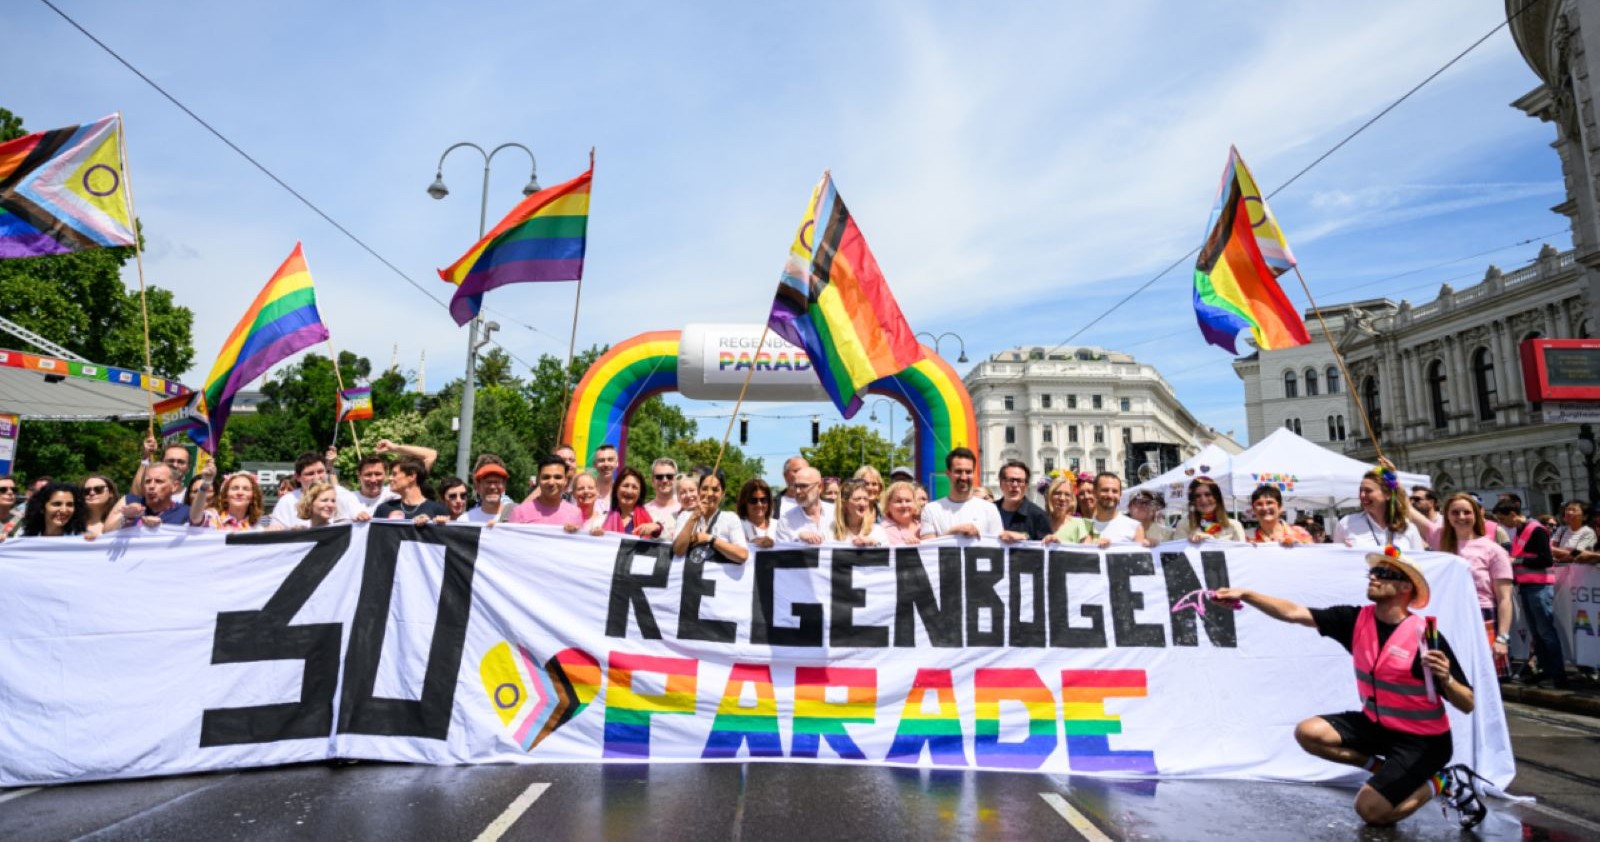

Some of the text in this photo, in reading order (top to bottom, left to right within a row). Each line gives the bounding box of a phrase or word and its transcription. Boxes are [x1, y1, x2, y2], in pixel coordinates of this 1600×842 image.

[200, 523, 480, 747] 30
[605, 539, 1237, 648] REGENBOGEN
[603, 650, 1157, 774] PARADE
